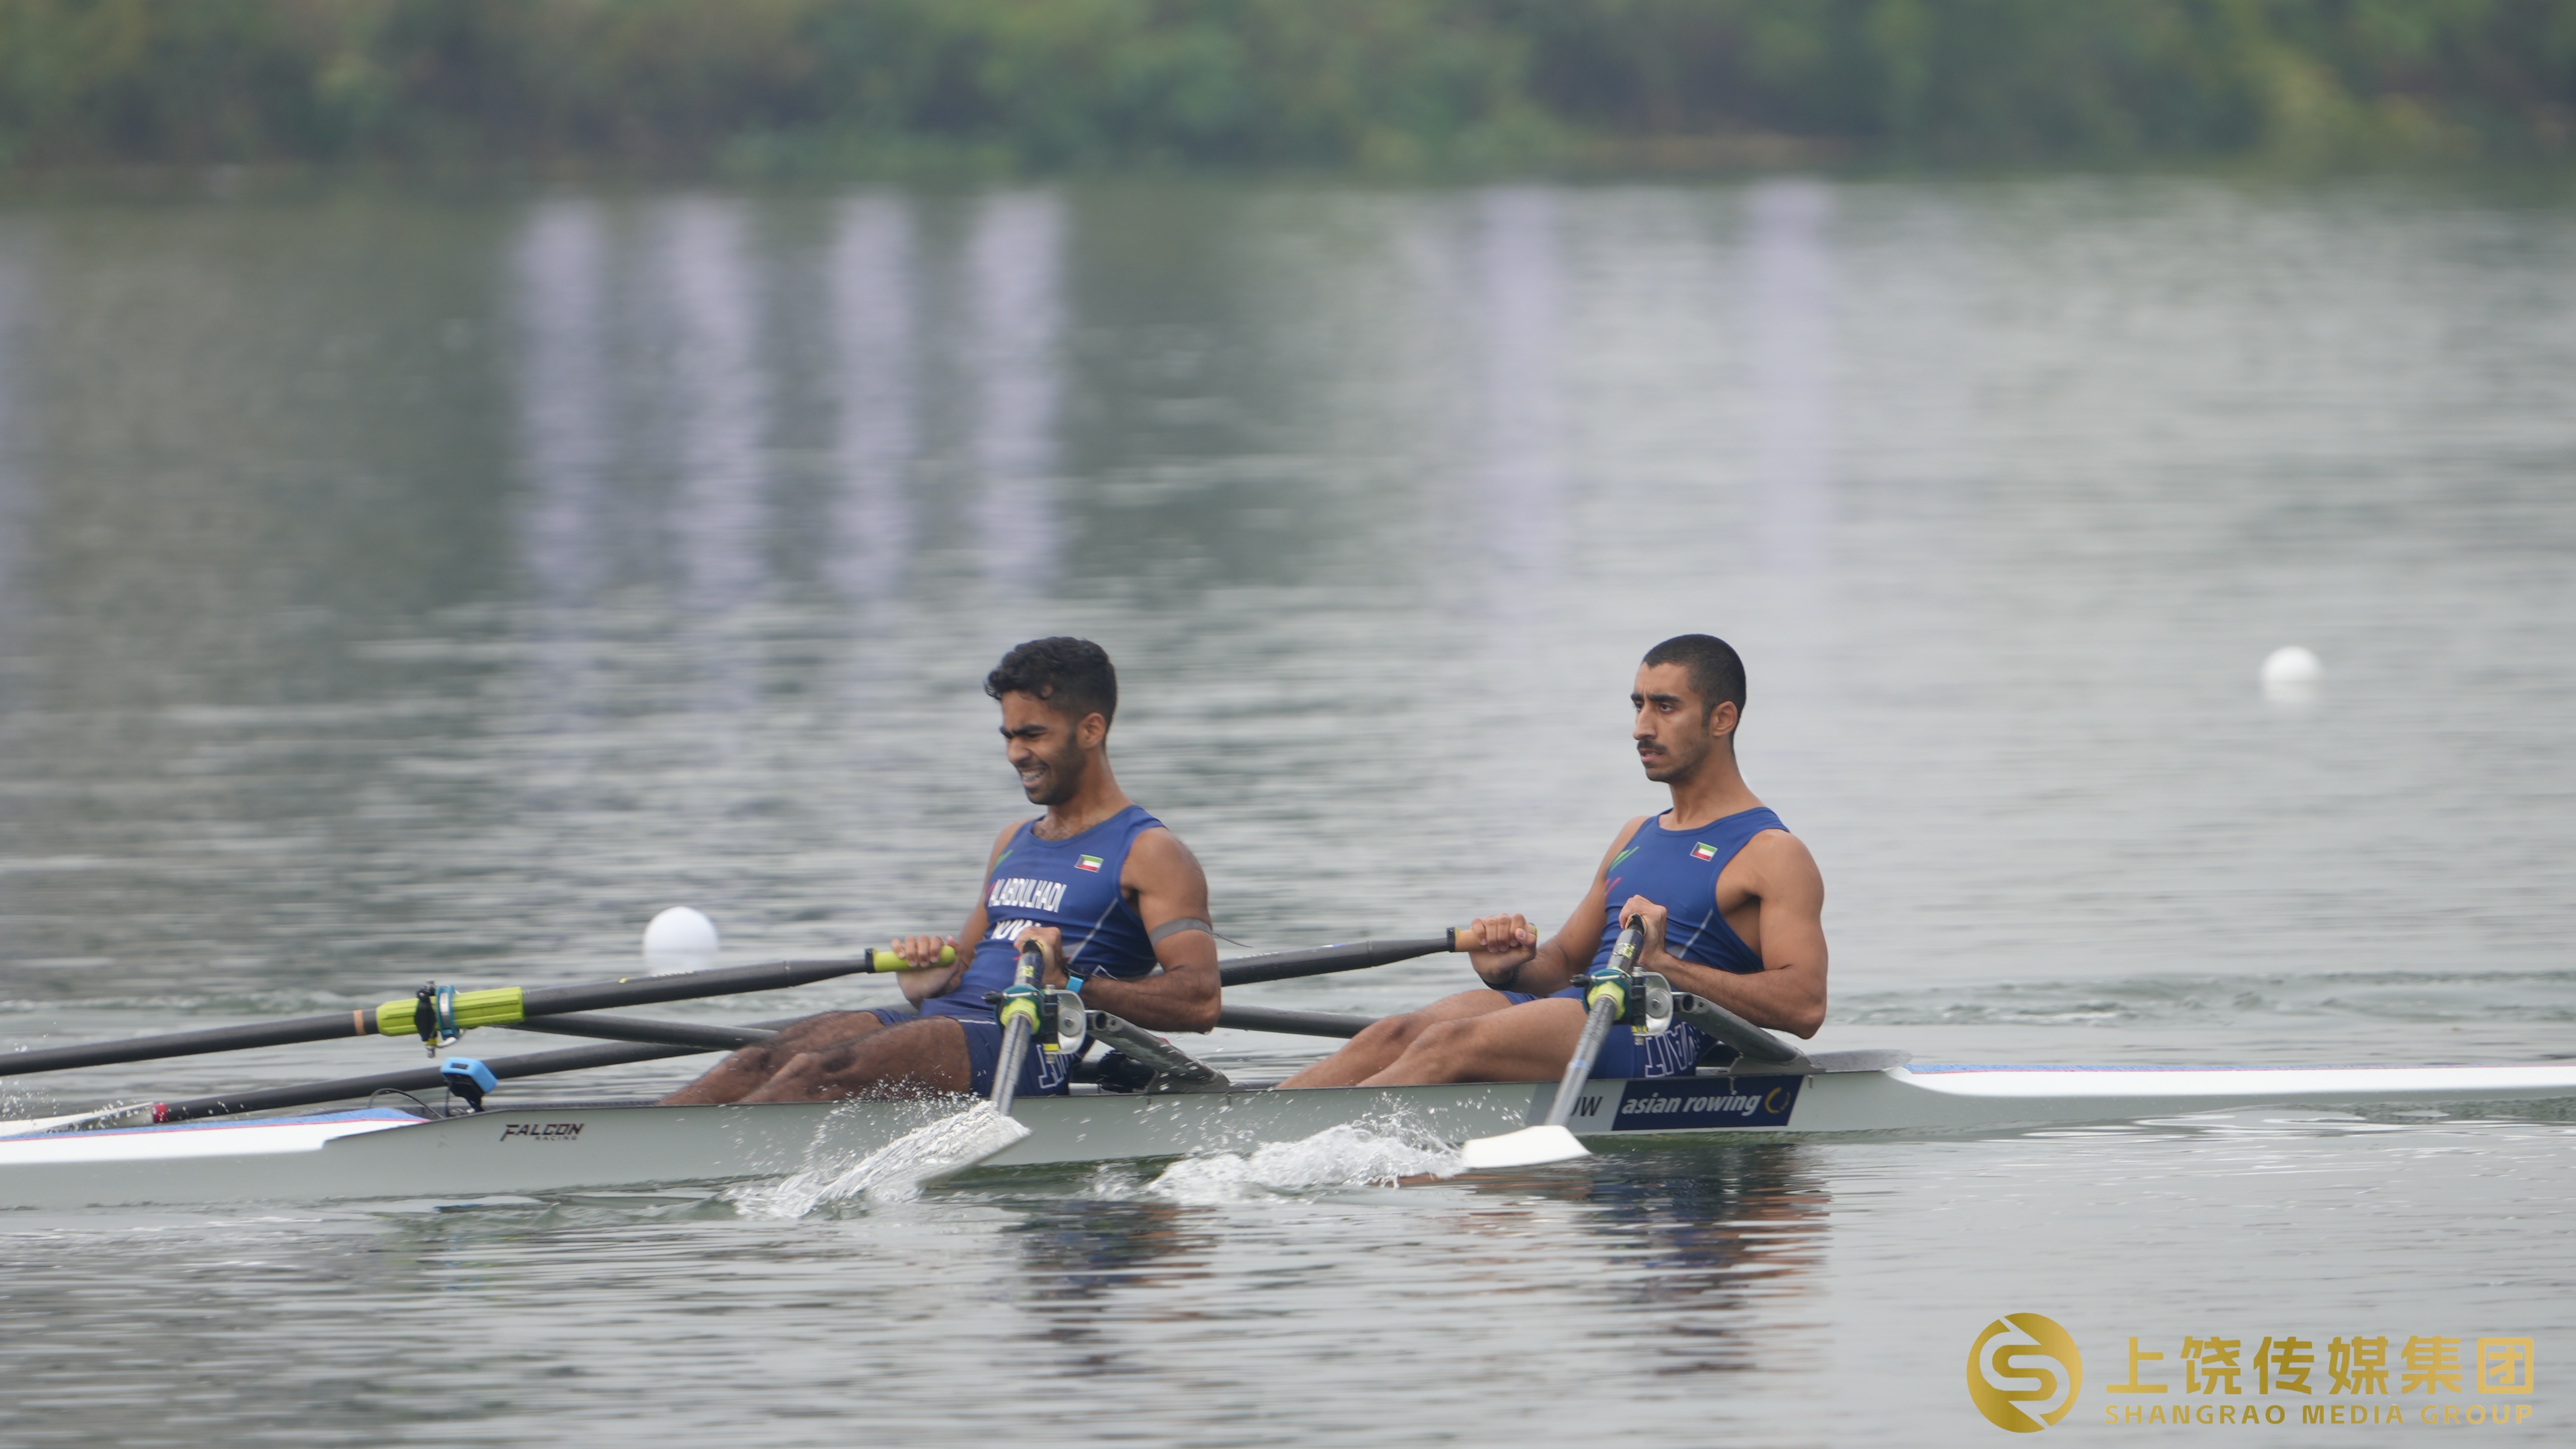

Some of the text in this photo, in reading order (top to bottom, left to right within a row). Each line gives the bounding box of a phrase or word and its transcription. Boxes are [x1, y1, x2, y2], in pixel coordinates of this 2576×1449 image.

[1622, 1091, 1763, 1116] asian rowing
[499, 1124, 585, 1142] FALCON
